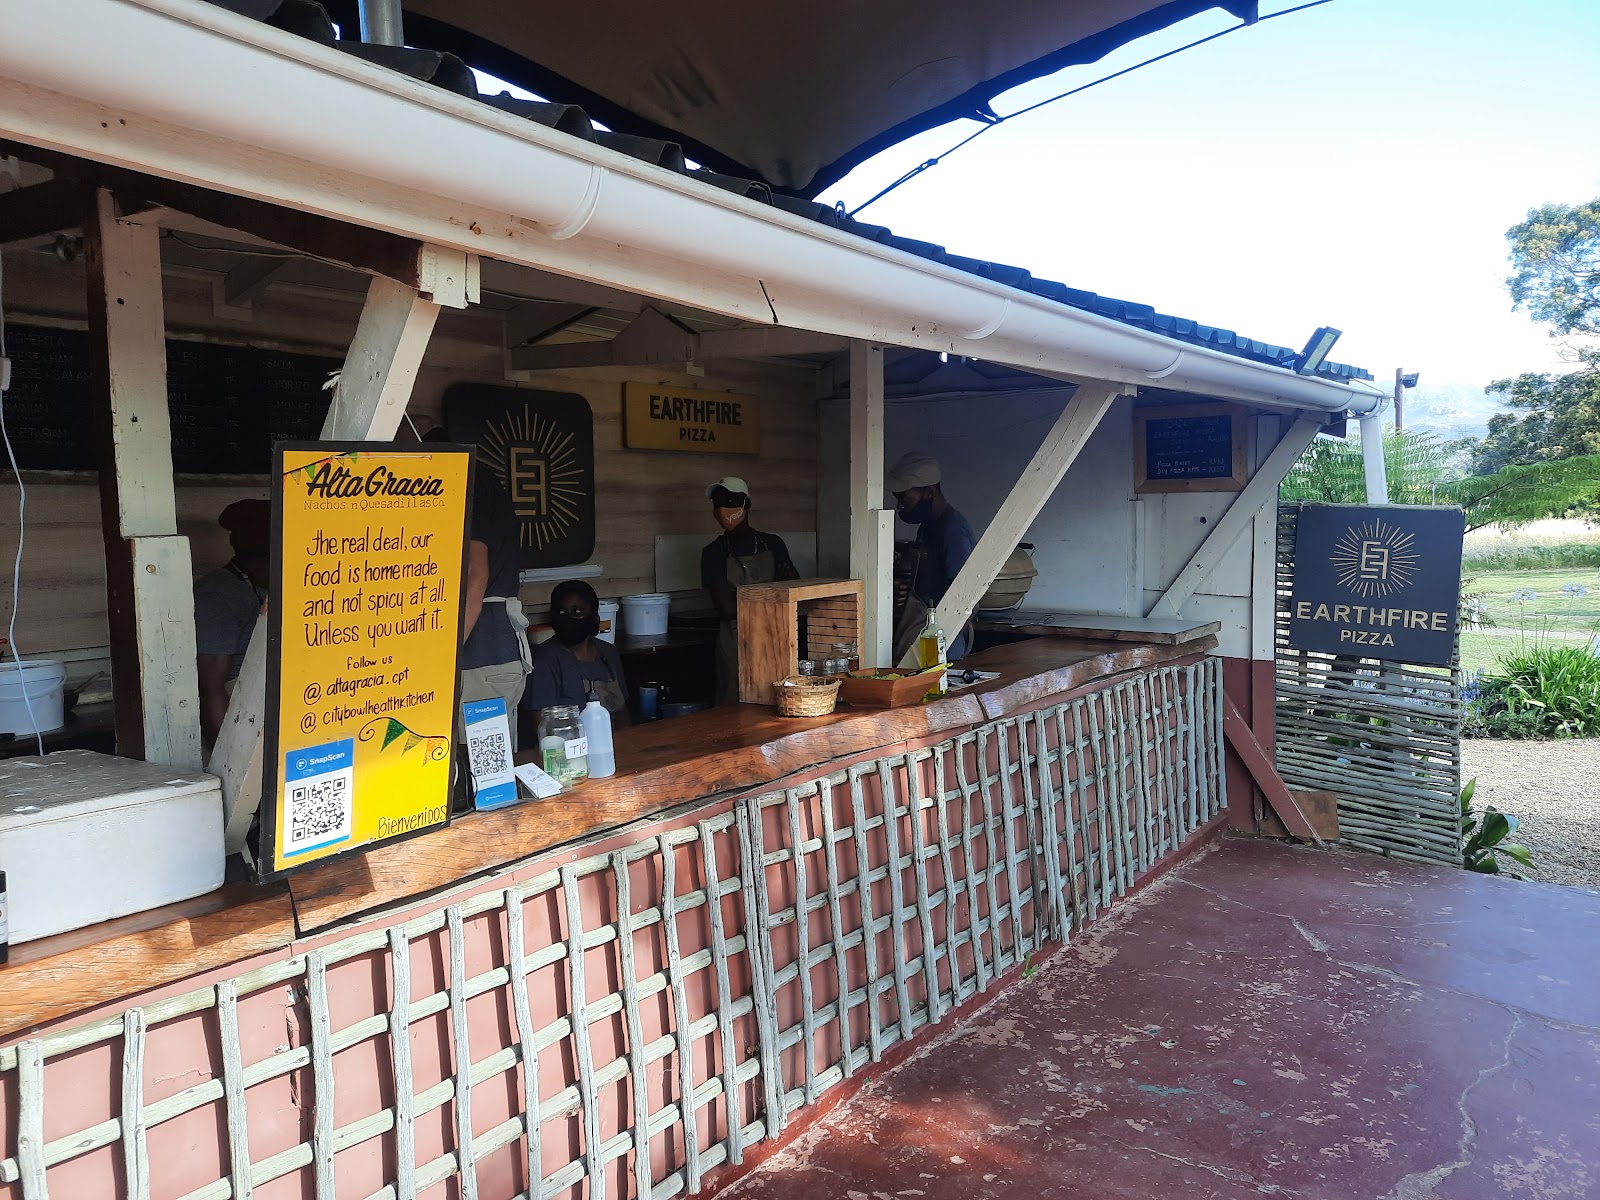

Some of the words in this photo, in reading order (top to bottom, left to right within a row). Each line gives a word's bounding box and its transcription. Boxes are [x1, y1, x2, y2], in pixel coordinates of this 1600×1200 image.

[649, 395, 742, 426] EARTHFIRE
[679, 427, 716, 442] PIZZA
[306, 463, 366, 498] Alta
[365, 465, 445, 498] Gracia
[304, 499, 346, 510] Nachos
[341, 527, 370, 554] real
[372, 527, 408, 552] deal,
[410, 532, 434, 549] our
[303, 561, 341, 587] food
[348, 565, 360, 583] is
[364, 555, 438, 582] homemade
[302, 590, 335, 617] and
[341, 587, 363, 612] not
[367, 591, 404, 616] spicy
[409, 580, 428, 605] at
[429, 578, 447, 603] all.
[304, 622, 360, 647] Unless
[367, 623, 392, 648] you
[396, 608, 428, 634] want
[430, 607, 444, 631] it.
[1296, 601, 1449, 632] EARTHFIRE
[1340, 629, 1395, 647] PIZZA
[382, 655, 393, 664] us
[475, 705, 498, 714] SnapScan
[309, 751, 345, 766] SnapScan
[569, 741, 587, 755] TIP
